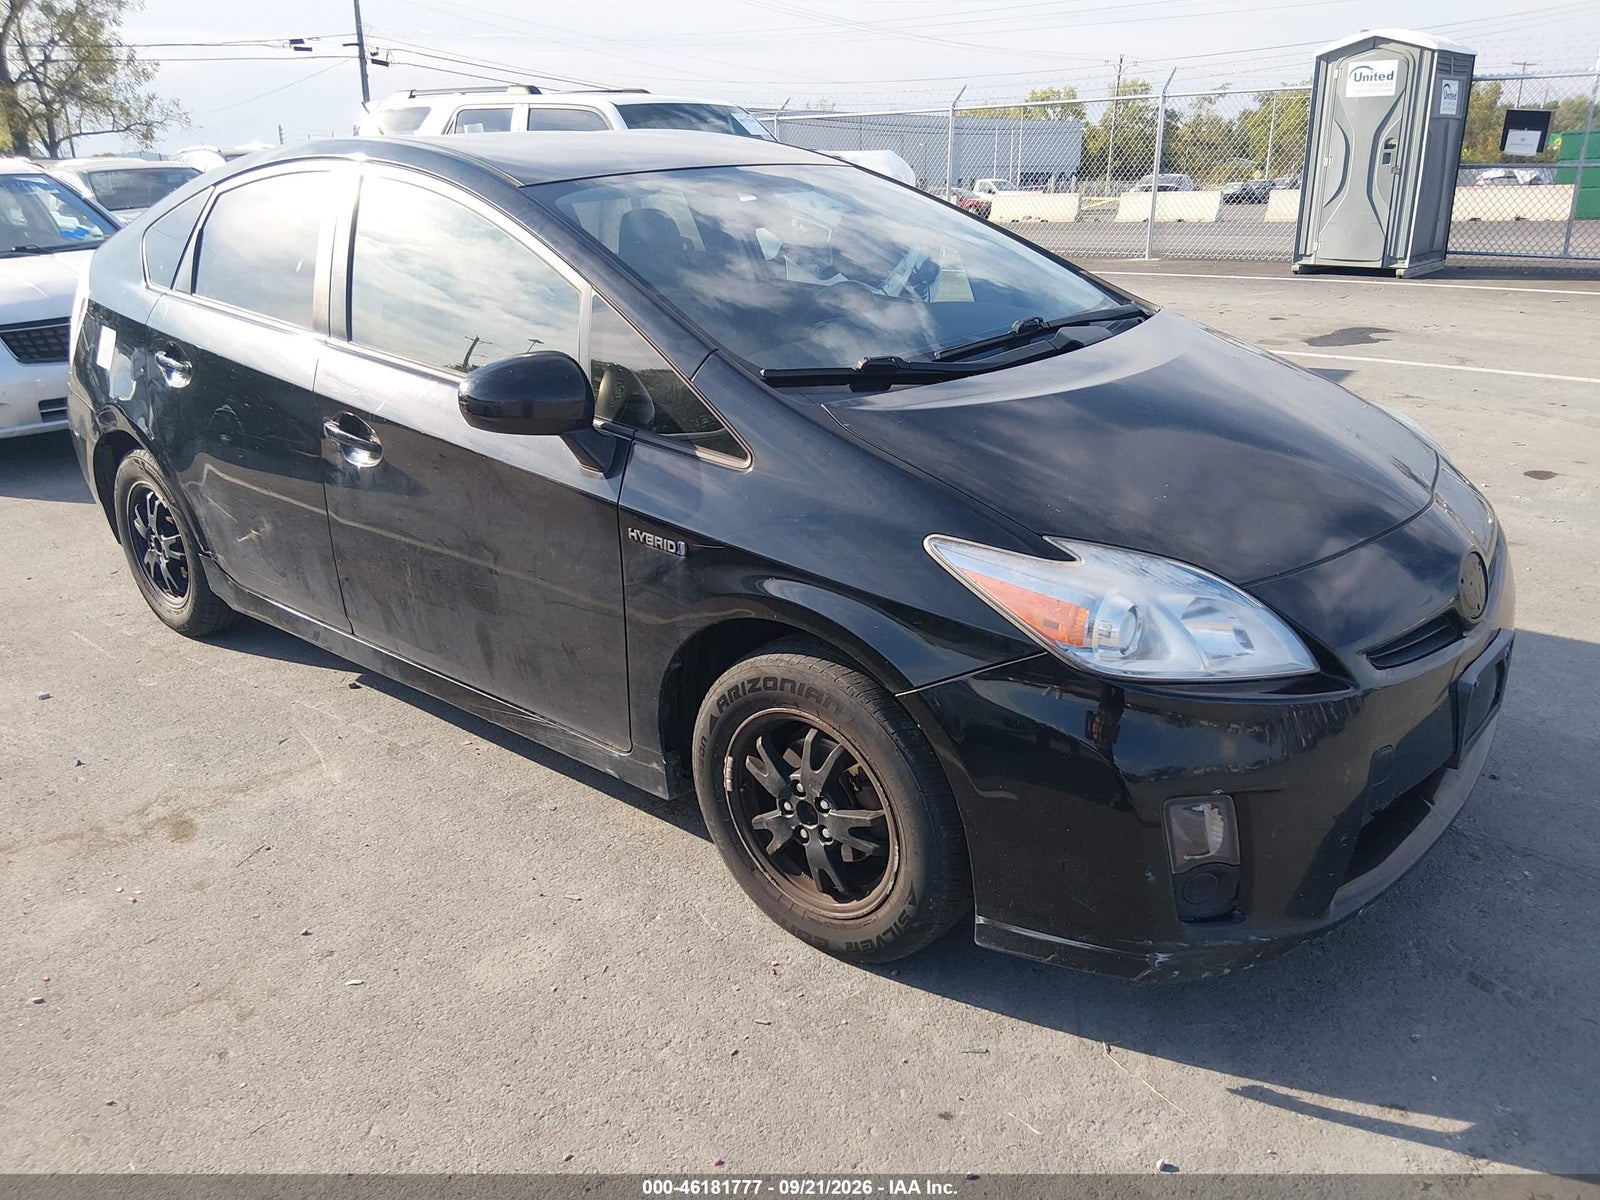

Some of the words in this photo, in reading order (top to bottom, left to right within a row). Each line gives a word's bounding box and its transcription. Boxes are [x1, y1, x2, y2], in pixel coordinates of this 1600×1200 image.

[1353, 70, 1394, 83] United
[627, 527, 676, 553] HYBRID
[716, 676, 844, 715] ARIZONIAN
[844, 908, 912, 953] SILVER
